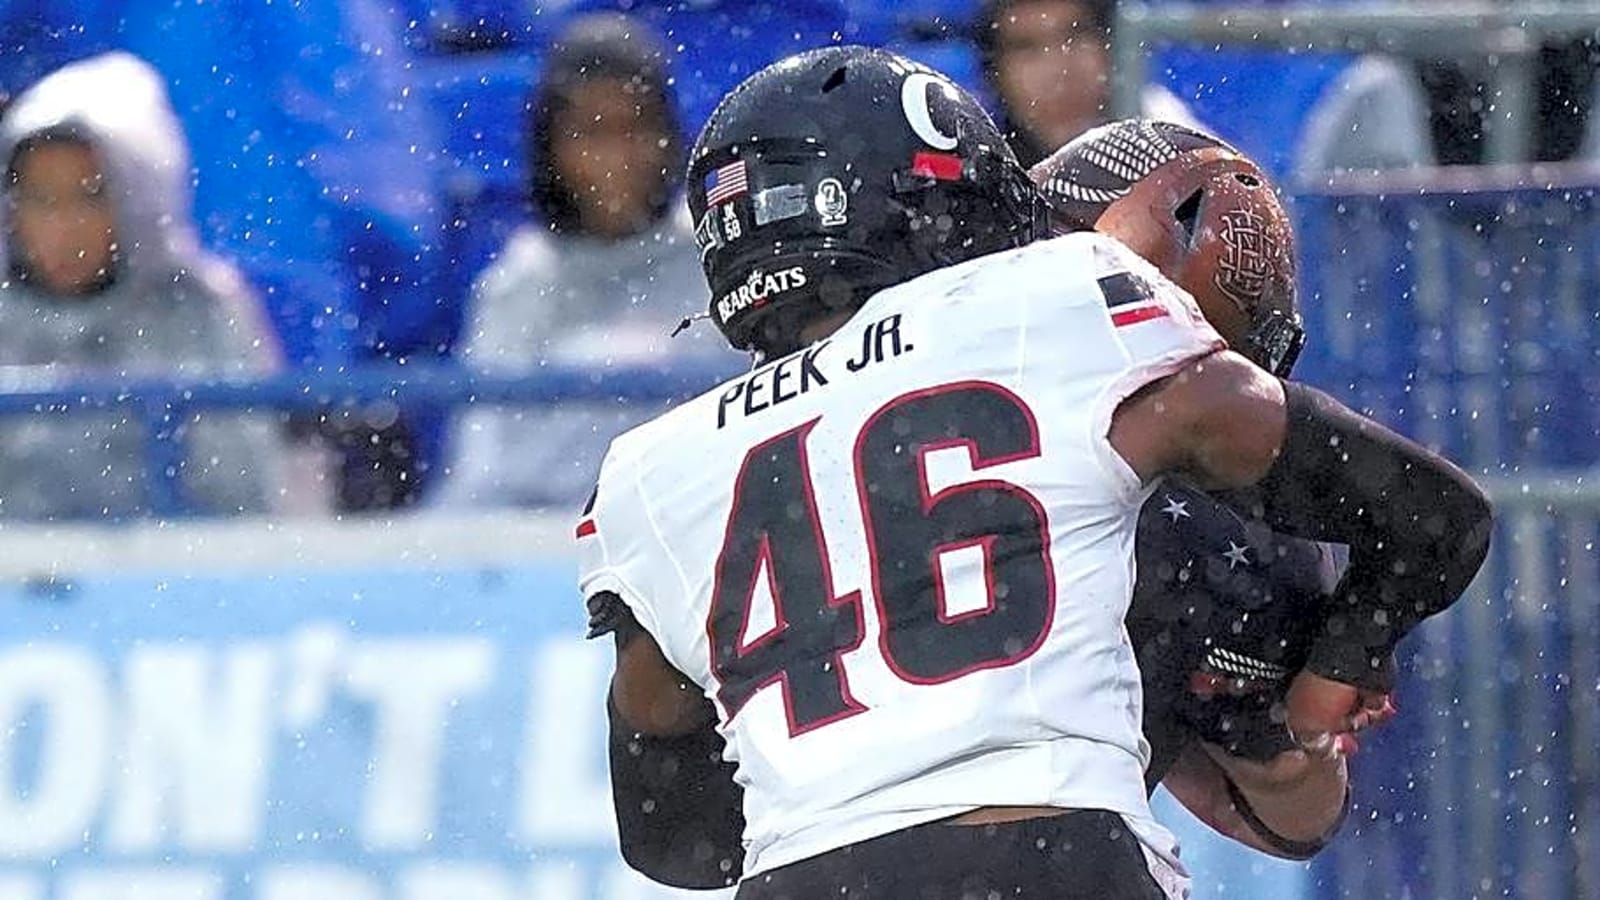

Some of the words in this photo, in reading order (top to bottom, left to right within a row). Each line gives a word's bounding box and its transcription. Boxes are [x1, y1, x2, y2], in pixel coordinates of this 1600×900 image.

[725, 219, 741, 241] 58
[717, 267, 806, 323] BEARCATS
[717, 341, 832, 429] PEEK
[846, 313, 914, 372] JR.
[707, 380, 1056, 739] 46
[0, 624, 494, 852] ON'T
